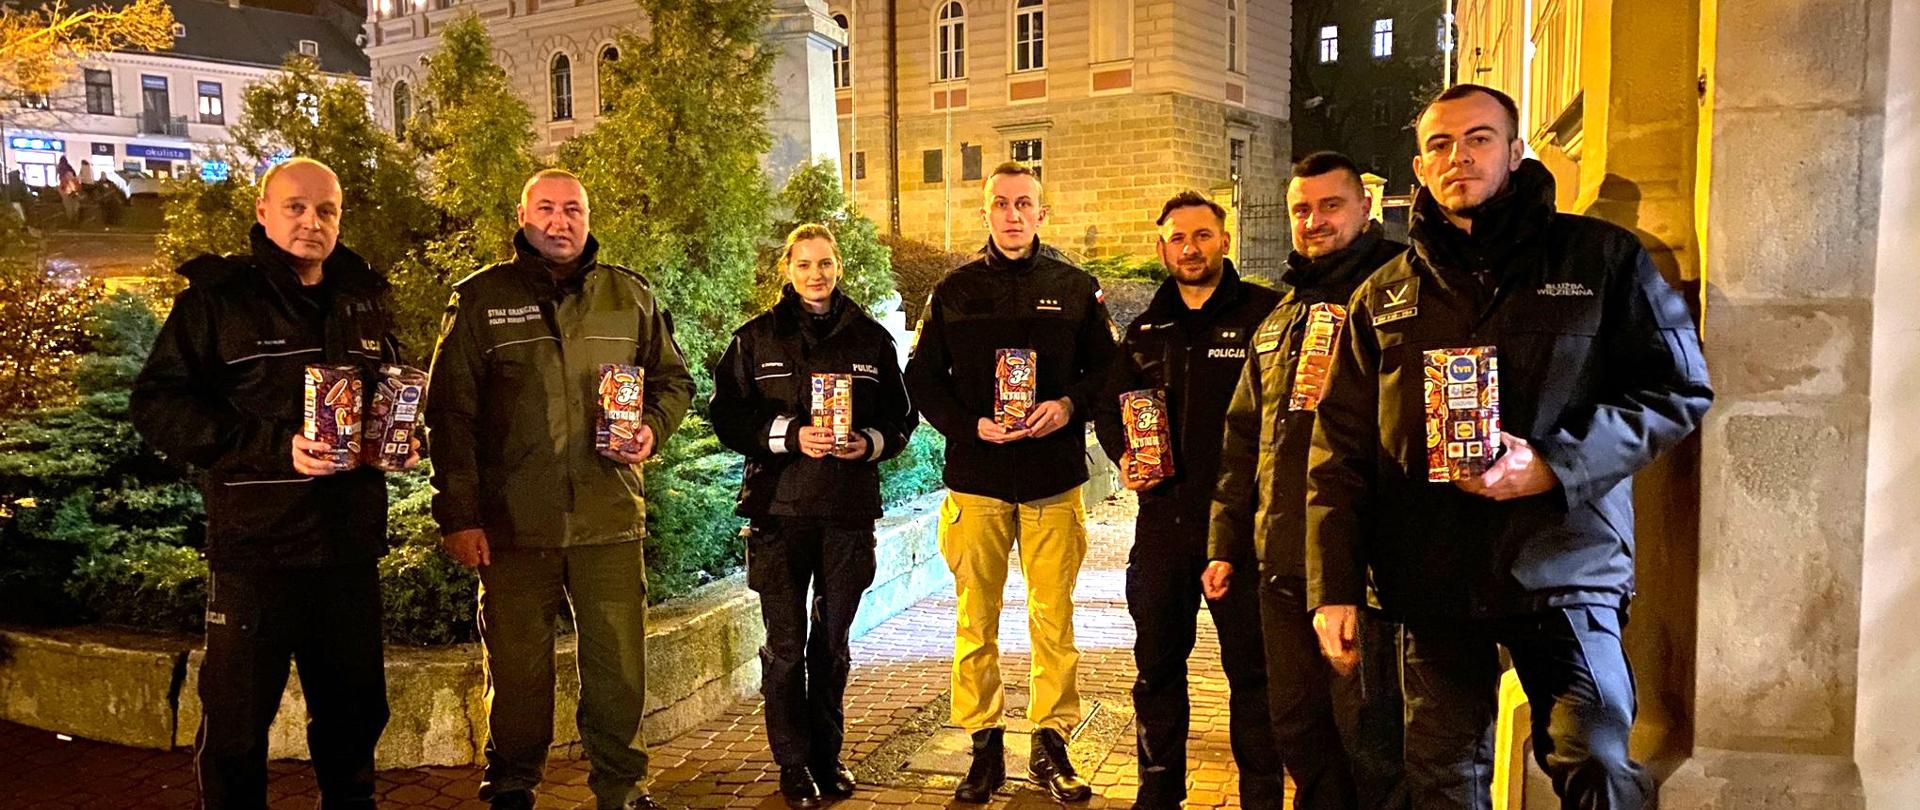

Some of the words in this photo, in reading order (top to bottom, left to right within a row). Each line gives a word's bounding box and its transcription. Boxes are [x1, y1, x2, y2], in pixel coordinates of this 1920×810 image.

[145, 149, 184, 158] okulista
[1536, 289, 1594, 297] WIĘZIENNA
[508, 305, 540, 316] GRANICZNA
[1208, 348, 1245, 359] POLICJA
[1453, 364, 1472, 374] tvn
[1008, 367, 1032, 385] 32
[616, 384, 640, 404] 32
[1137, 408, 1160, 430] 32
